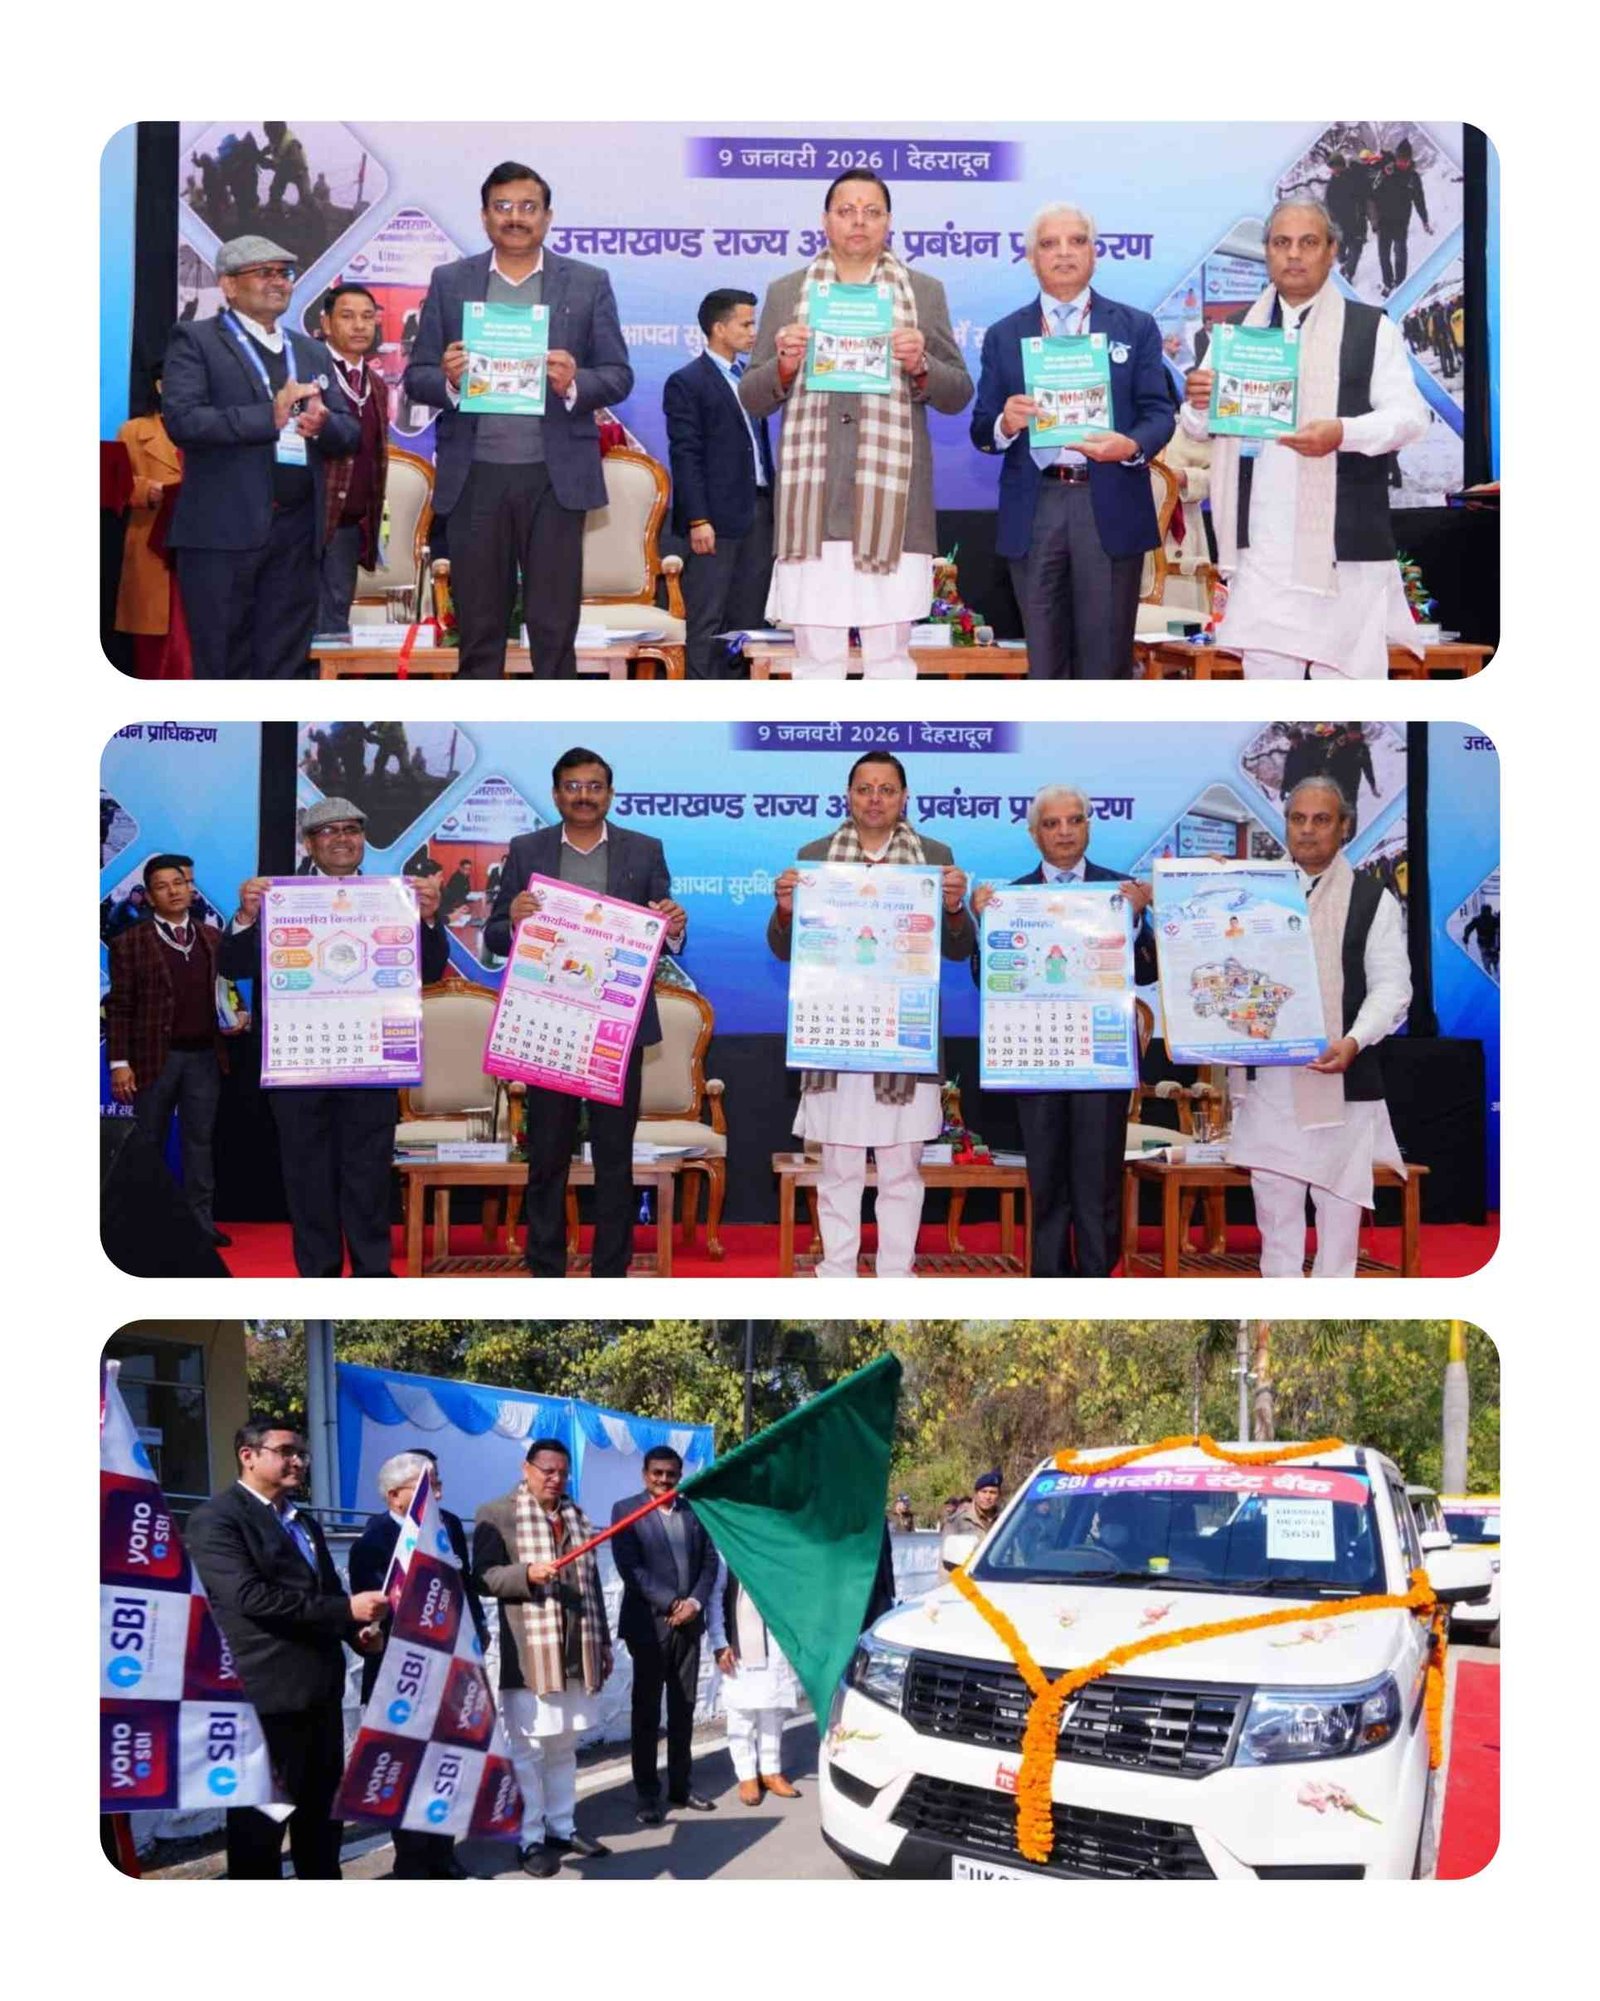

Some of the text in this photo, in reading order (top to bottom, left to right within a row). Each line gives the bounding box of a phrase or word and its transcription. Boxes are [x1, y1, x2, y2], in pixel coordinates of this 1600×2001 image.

[718, 149, 732, 168] 9
[740, 147, 817, 169] जनवरी
[827, 149, 883, 169] 2026
[907, 149, 990, 177] देहरादून
[552, 226, 703, 259] उत्तराखण्ड
[714, 229, 789, 257] राज्य
[904, 221, 999, 262] प्रबंधन
[147, 721, 218, 743] प्राधिकरण
[758, 726, 771, 742] 9
[778, 721, 842, 742] जनवरी
[851, 726, 900, 742] 2026
[921, 722, 993, 750] देहरादून
[615, 793, 746, 819] उत्तराखण्ड
[753, 794, 819, 818] राज्य
[917, 787, 1001, 823] प्रबंधन
[672, 875, 723, 895] आपदा
[1055, 1475, 1088, 1491] SBI
[127, 1502, 152, 1565] yono
[154, 1514, 171, 1541] SBI
[419, 1578, 442, 1628] yono
[111, 1597, 147, 1651] SBI
[397, 1651, 426, 1697] SBI
[458, 1680, 478, 1729] yono
[111, 1723, 135, 1788] yono
[134, 1732, 152, 1760] SBI
[208, 1712, 238, 1761] SBI
[362, 1752, 391, 1805] yono
[434, 1754, 463, 1796] SBI
